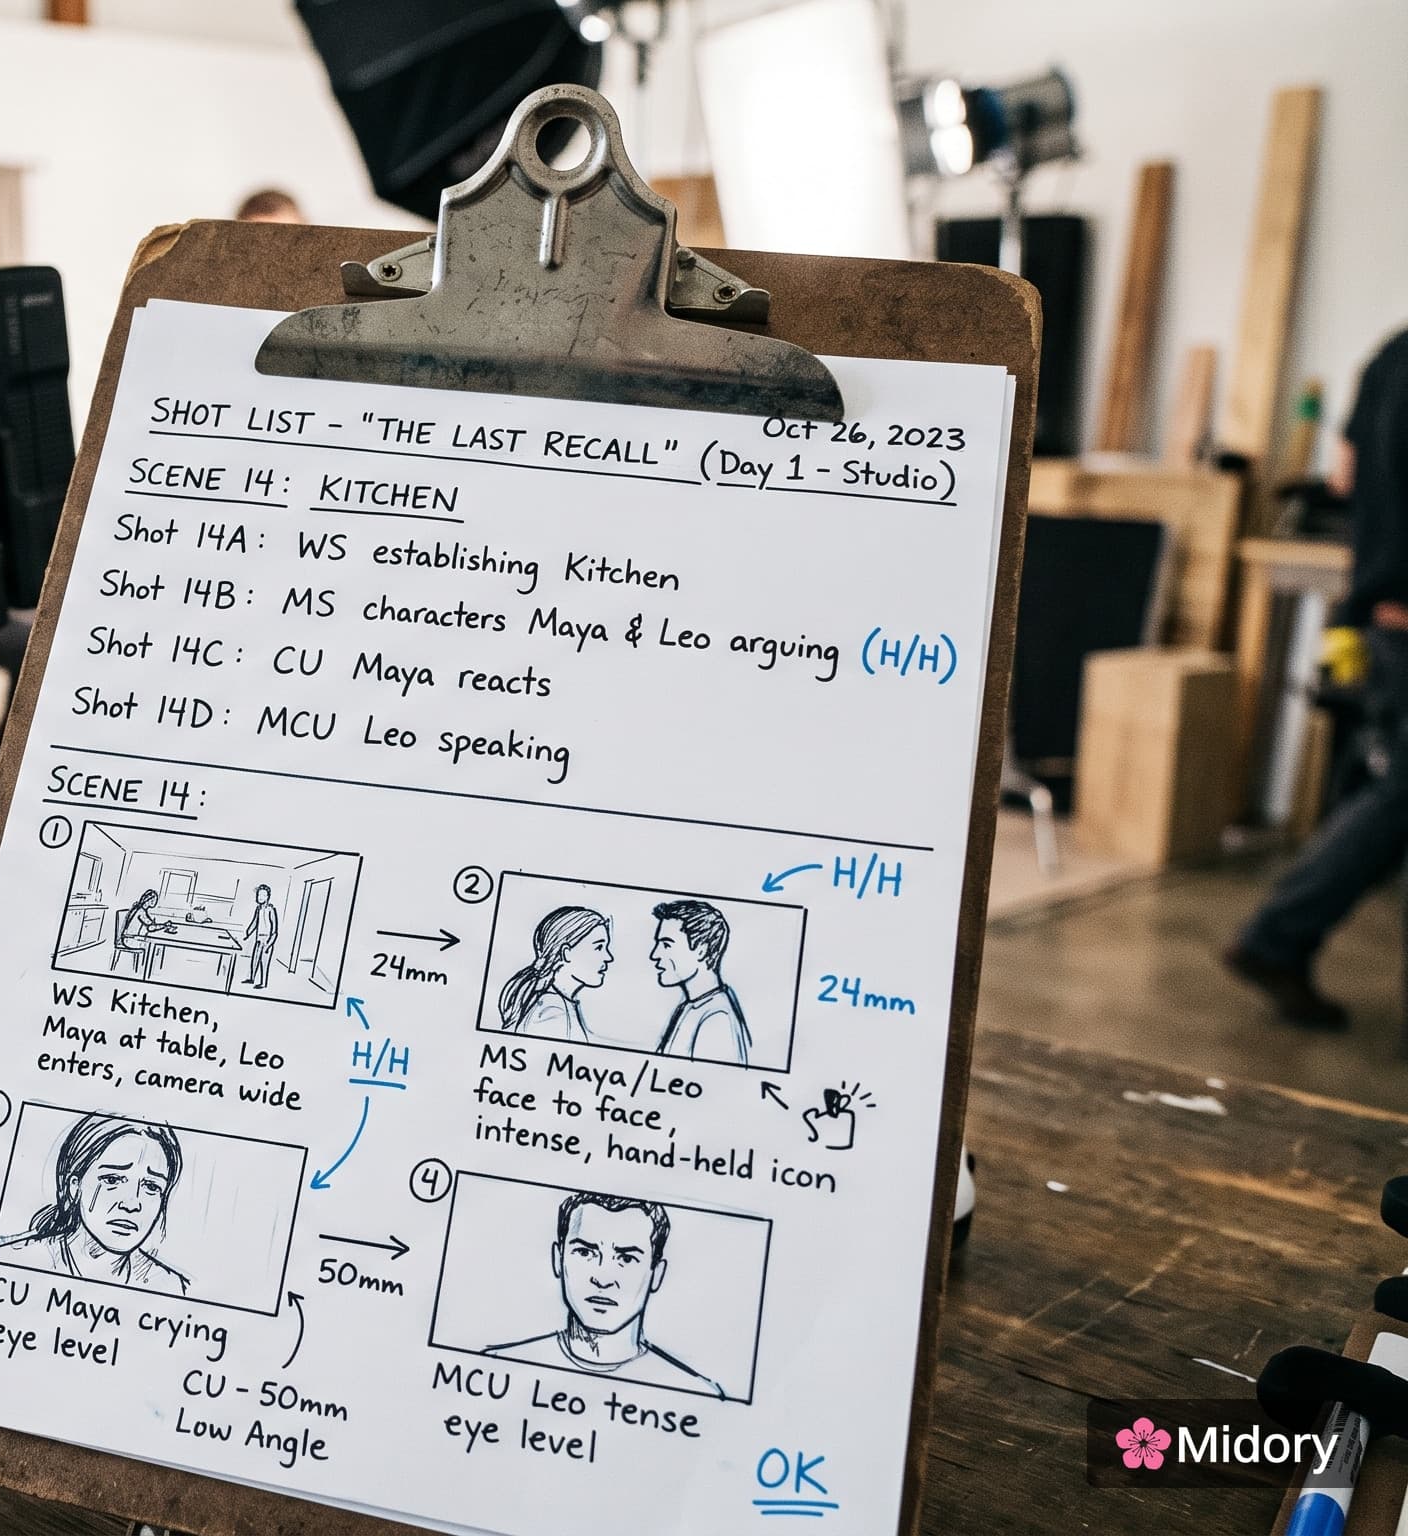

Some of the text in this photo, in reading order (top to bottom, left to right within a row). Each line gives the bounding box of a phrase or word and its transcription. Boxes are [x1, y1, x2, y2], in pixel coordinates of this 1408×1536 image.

[150, 397, 232, 428] SHOT
[247, 406, 316, 435] LIST
[362, 411, 436, 445] "THE
[452, 424, 527, 453] LAST
[543, 430, 678, 465] RECALL"
[700, 439, 774, 491] (Day
[786, 454, 805, 481] 1
[842, 459, 956, 501] Studio)
[762, 415, 966, 452] Oct 26, 2023
[129, 457, 227, 491] SCENE
[319, 474, 459, 513] KITCHEN
[113, 513, 179, 545] Shot
[299, 531, 347, 561] WS
[372, 539, 539, 595] establishing
[564, 551, 679, 591] Kitchen
[99, 569, 165, 601] Shot
[281, 587, 336, 618] MS
[363, 594, 506, 632] characters
[528, 606, 609, 653] Maya
[624, 612, 643, 649] &
[659, 617, 711, 650] Leo
[729, 634, 840, 683] arguing
[861, 626, 958, 685] (H/H)
[86, 626, 154, 659] Shot
[273, 645, 323, 676] CU
[352, 652, 435, 698] Maya
[458, 665, 551, 697] reacts
[71, 686, 139, 720] Shot
[256, 706, 337, 741] MCU
[363, 714, 417, 748] Leo
[438, 728, 570, 785] speaking
[47, 765, 143, 803] SCENE
[833, 852, 902, 900] H/H
[370, 952, 448, 986] 24mm
[817, 974, 916, 1015] 24mm
[53, 982, 218, 1033] WS Kitchen,
[42, 1015, 285, 1070] Maya at table, Leo
[352, 1037, 409, 1078] H/H
[37, 1050, 302, 1111] enters, camera wide
[479, 1043, 703, 1099] MS Maya/Leo
[472, 1076, 676, 1138] face to face,
[475, 1114, 836, 1193] intense, hand-held icon
[318, 1258, 404, 1297] 50mm
[46, 1287, 121, 1334] Maya
[138, 1312, 228, 1363] crying
[53, 1326, 119, 1367] level
[182, 1369, 226, 1399] CU
[259, 1381, 348, 1422] 50mm
[432, 1362, 701, 1438] MCU Leo tense
[175, 1406, 329, 1469] Low Angle
[443, 1415, 597, 1464] eye level
[756, 1447, 828, 1495] OK
